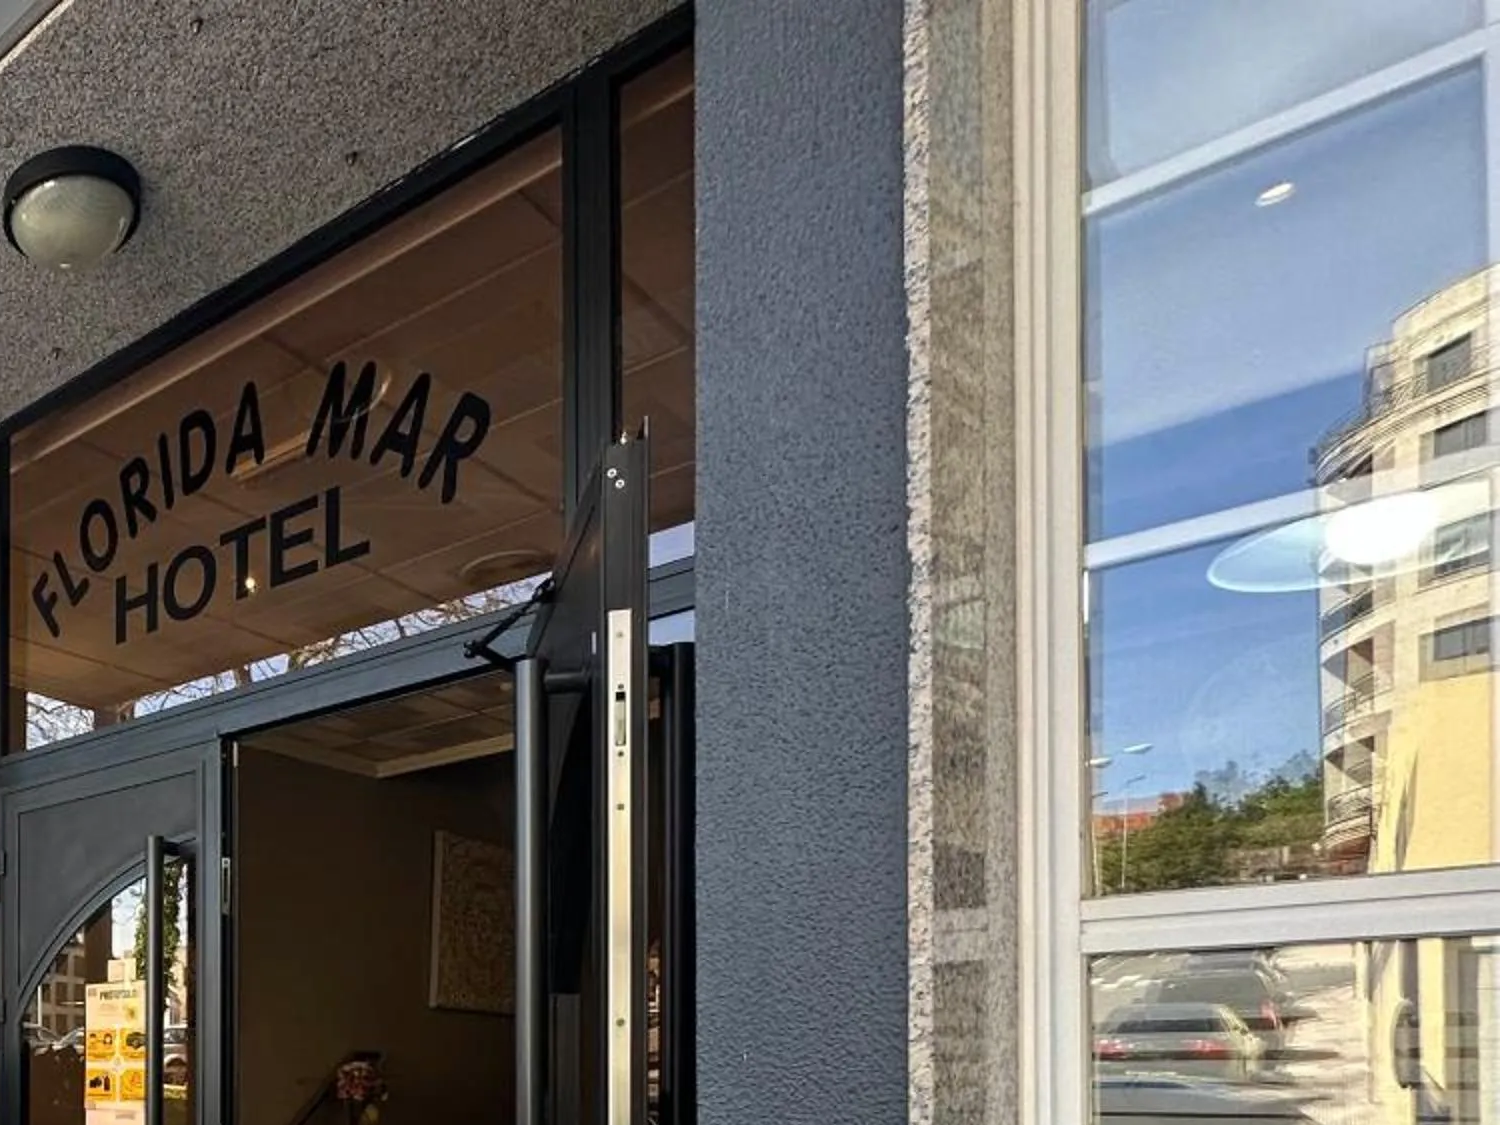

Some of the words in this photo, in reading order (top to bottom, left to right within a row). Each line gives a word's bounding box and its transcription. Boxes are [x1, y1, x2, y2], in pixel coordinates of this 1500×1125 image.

[31, 380, 265, 638] FLORIDA
[305, 360, 491, 503] MAR
[115, 485, 371, 645] HOTEL
